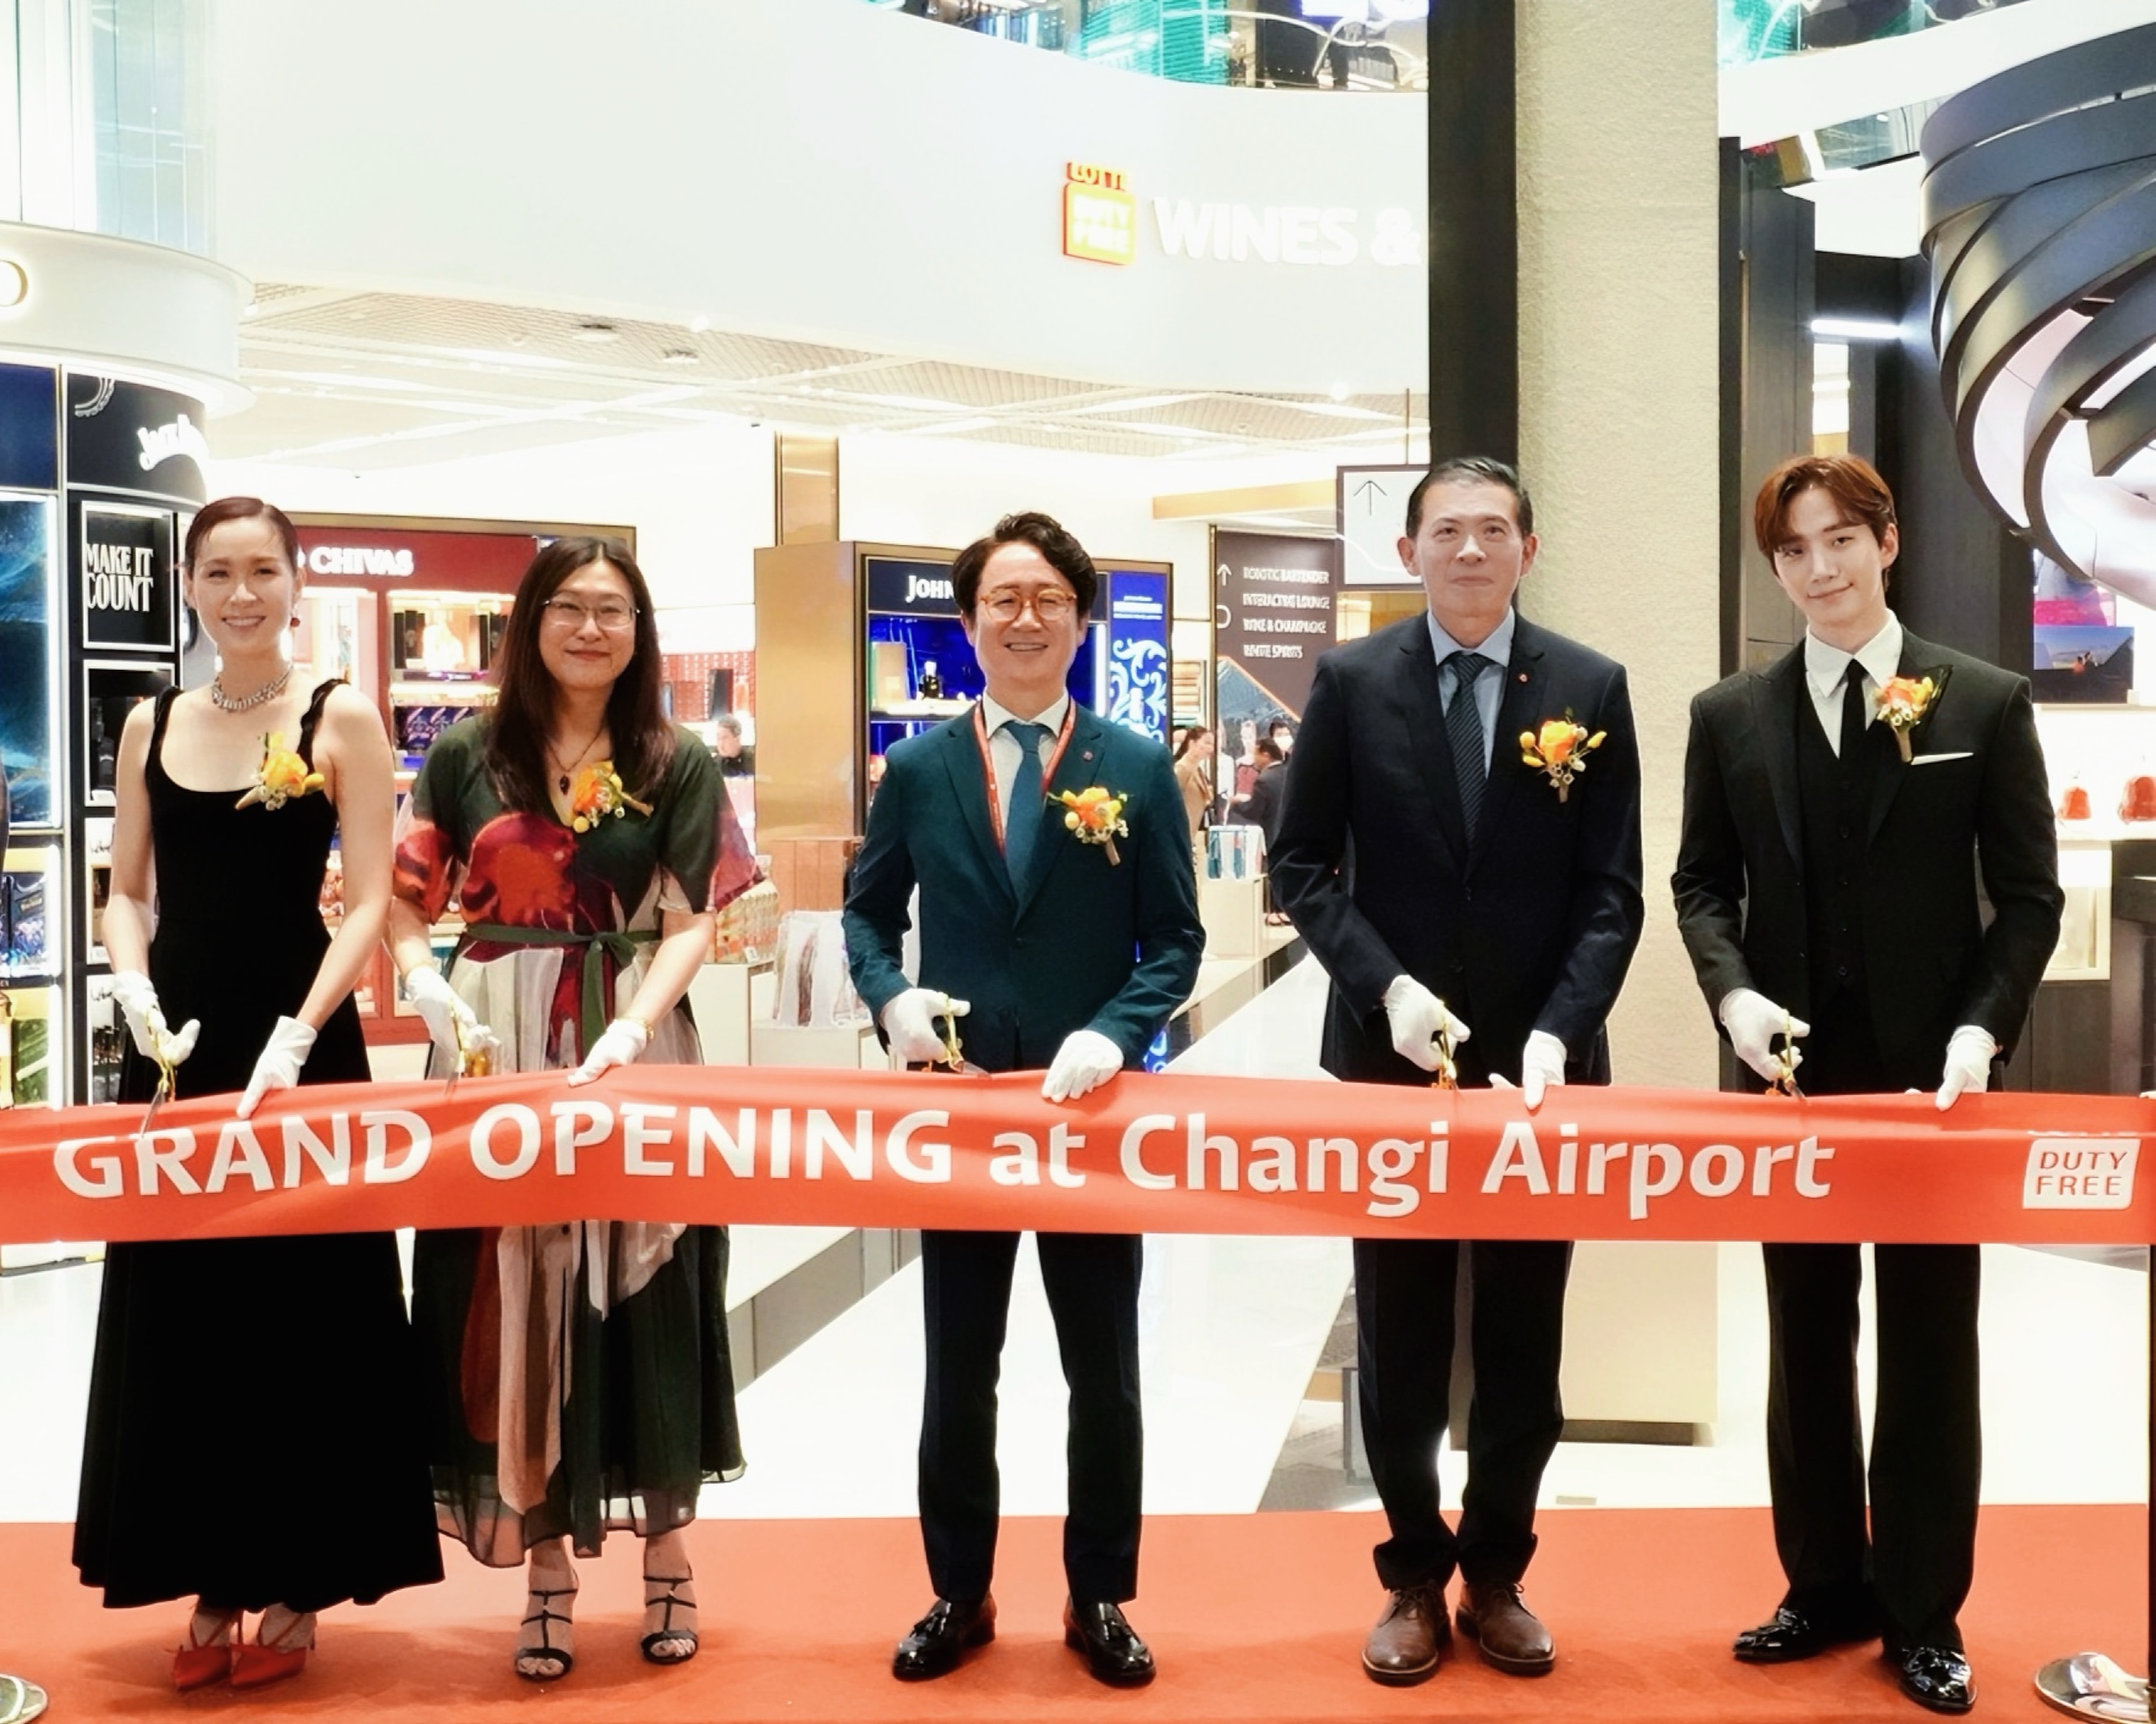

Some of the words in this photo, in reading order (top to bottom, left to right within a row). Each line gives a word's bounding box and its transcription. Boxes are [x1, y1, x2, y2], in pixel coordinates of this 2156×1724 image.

[1151, 196, 1360, 266] WINES
[1371, 206, 1423, 266] &
[86, 543, 131, 575] MAKE
[134, 547, 153, 577] IT
[309, 546, 415, 577] CHIVAS
[86, 573, 153, 612] COUNT
[53, 1109, 433, 1198] GRAND
[469, 1100, 953, 1184] OPENING
[988, 1122, 1087, 1188] at
[1120, 1112, 1450, 1218] Changi
[1481, 1120, 1835, 1220] Airport
[2039, 1150, 2127, 1171] DUTY
[2035, 1175, 2123, 1196] FREE
